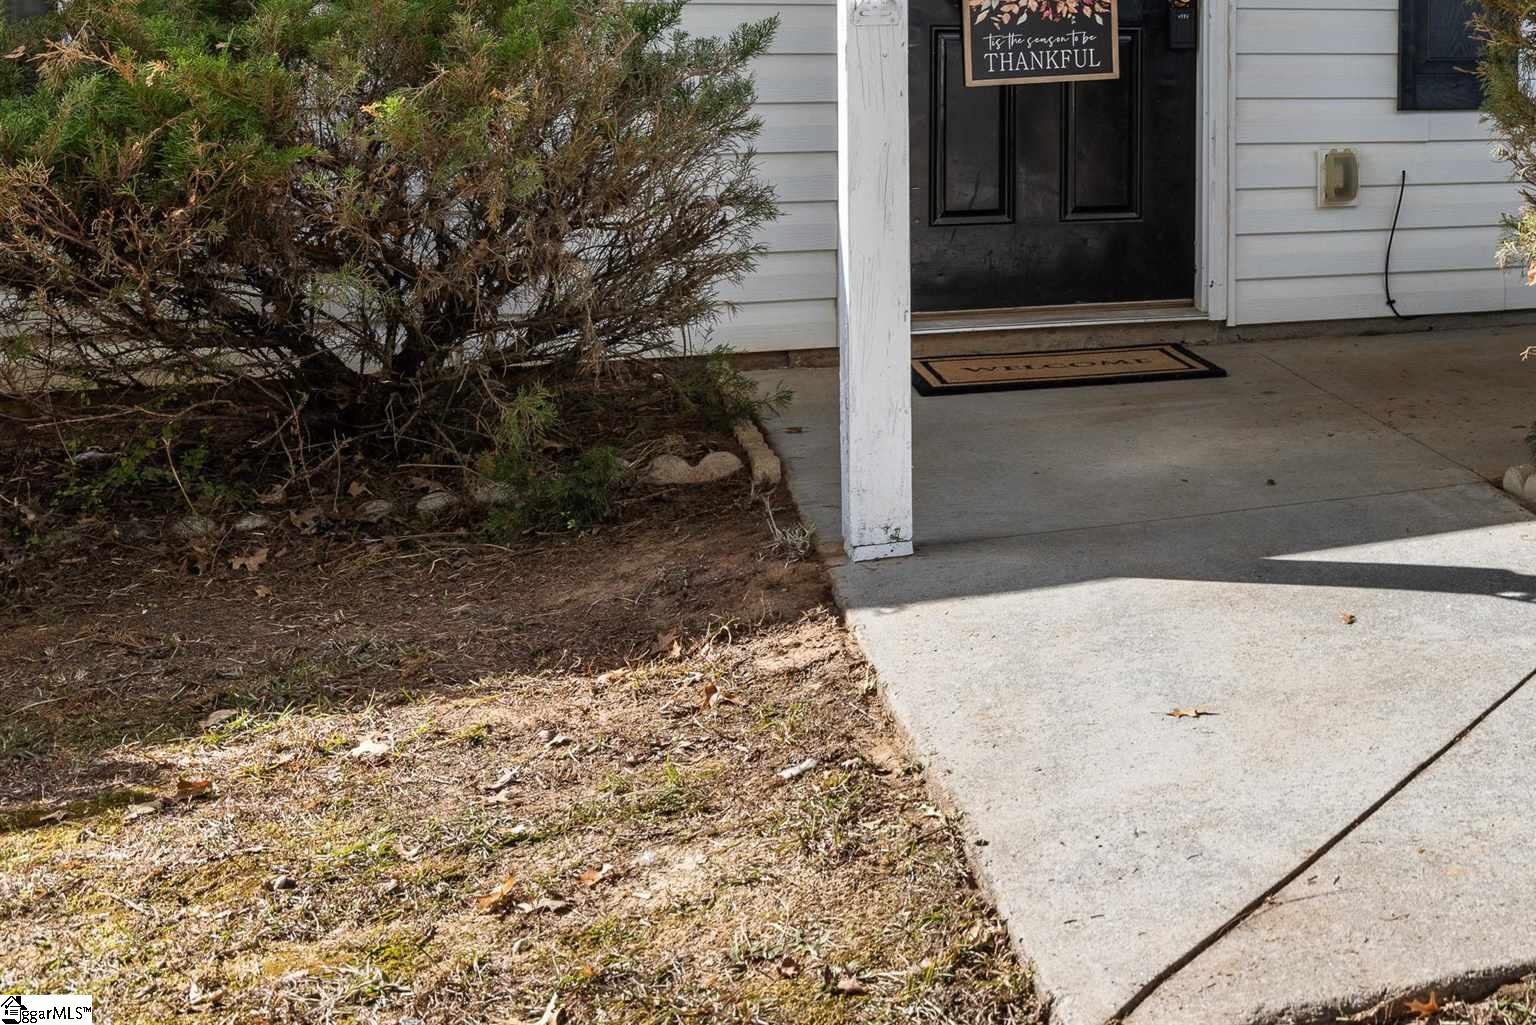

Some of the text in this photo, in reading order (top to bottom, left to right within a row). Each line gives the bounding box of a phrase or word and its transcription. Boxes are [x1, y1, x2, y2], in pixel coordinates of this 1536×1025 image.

[1005, 32, 1025, 50] the
[1026, 36, 1069, 49] season
[1066, 29, 1080, 47] to
[1081, 31, 1097, 45] be
[983, 48, 1101, 73] THANKFUL
[960, 359, 1153, 372] WELCOME
